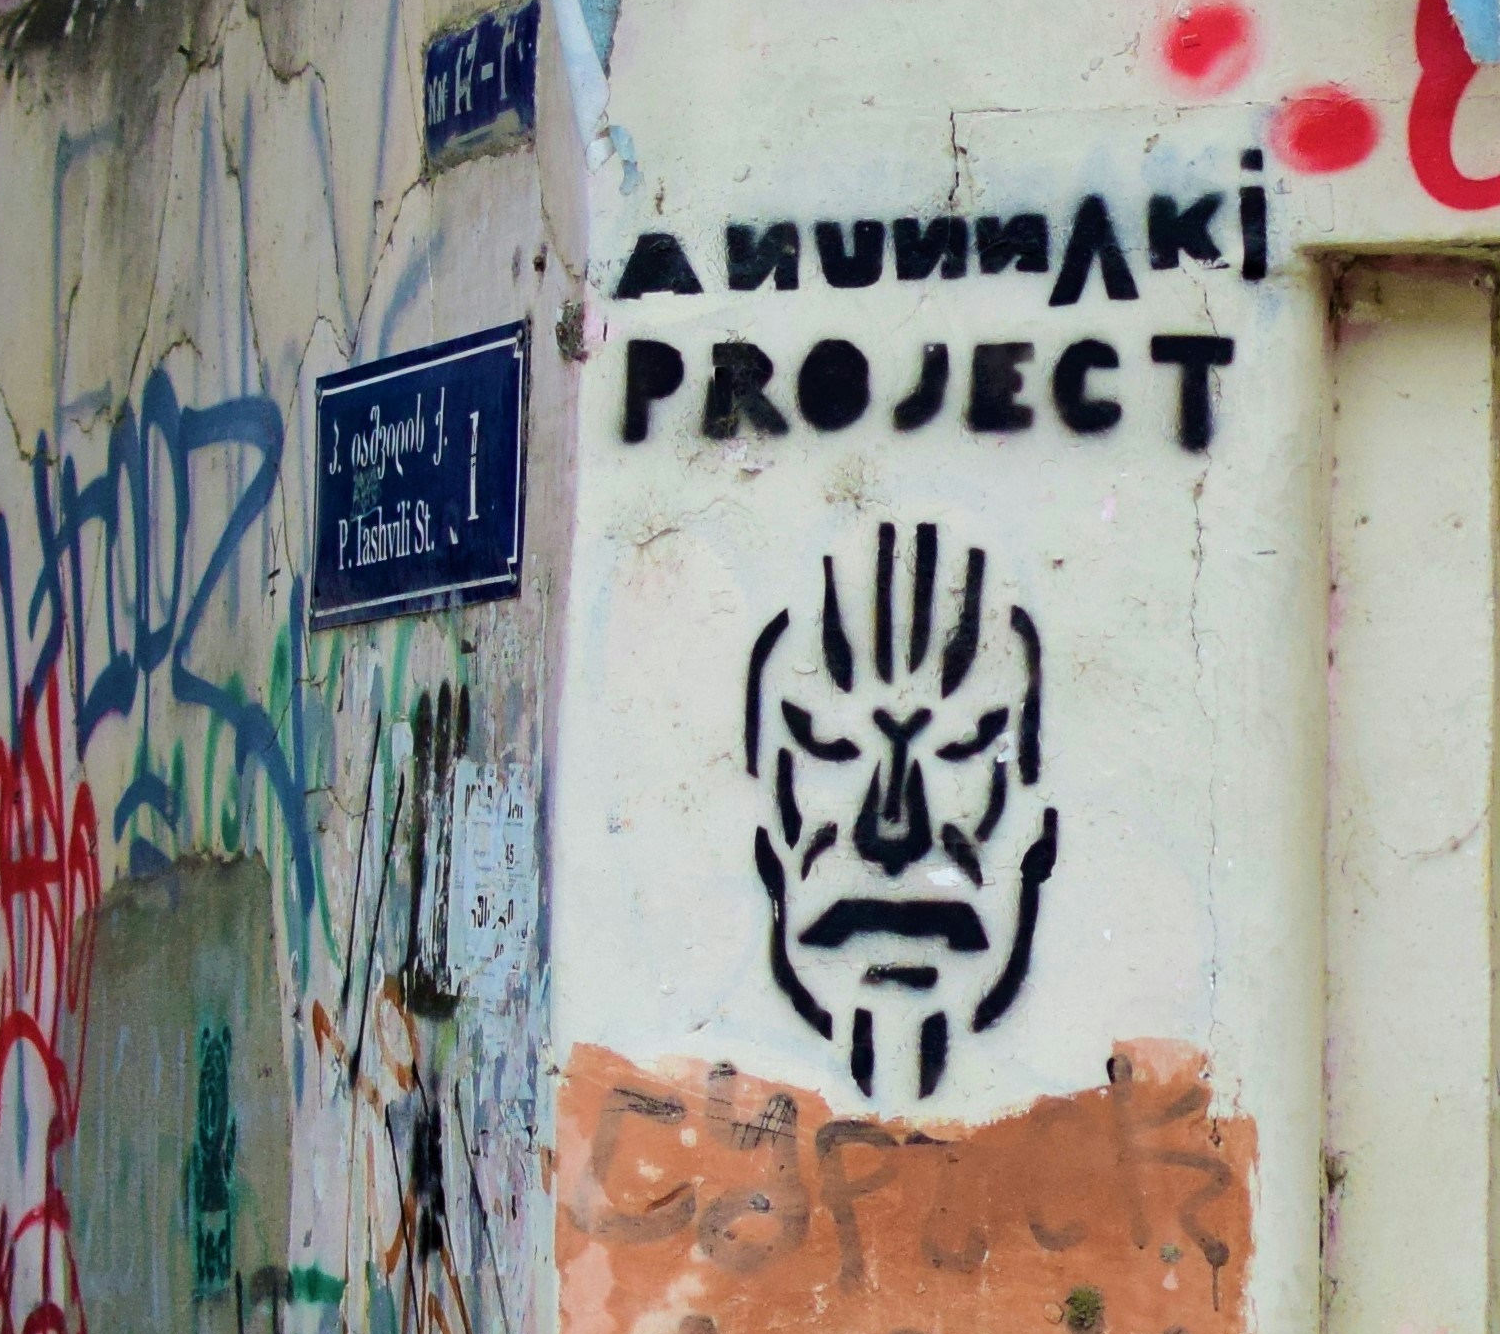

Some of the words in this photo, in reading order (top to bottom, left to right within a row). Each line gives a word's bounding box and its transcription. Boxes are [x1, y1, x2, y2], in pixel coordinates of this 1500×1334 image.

[351, 392, 426, 480] იაშვილის
[432, 385, 449, 467] ქ.
[620, 334, 1236, 454] PROJECT
[338, 517, 353, 571] P.
[354, 499, 411, 568] Iashvili
[413, 499, 436, 554] St.
